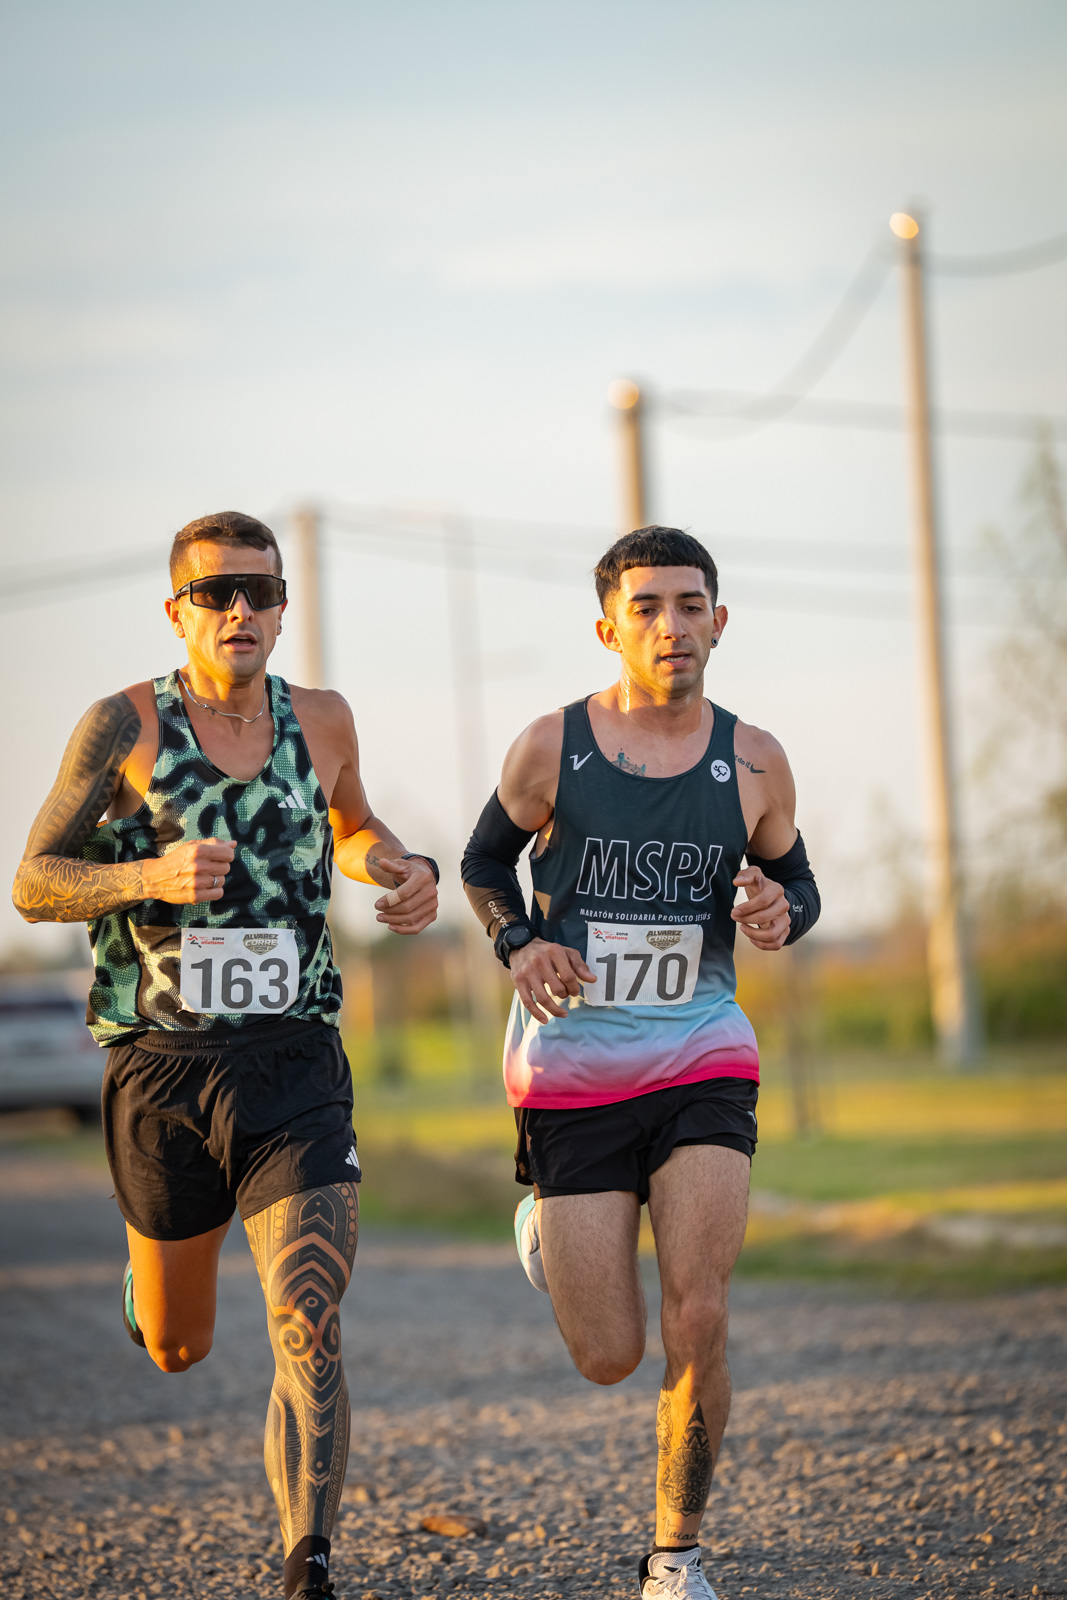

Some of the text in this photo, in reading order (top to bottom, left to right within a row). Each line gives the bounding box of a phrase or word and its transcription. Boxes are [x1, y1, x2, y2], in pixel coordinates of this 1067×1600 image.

[576, 837, 723, 902] MSPJ
[579, 908, 613, 919] MARATÓN
[615, 912, 656, 921] SOLIDARIA
[657, 914, 693, 923] PROYECTO
[245, 939, 278, 947] CORRE
[191, 957, 289, 1010] 163
[596, 952, 688, 1001] 170
